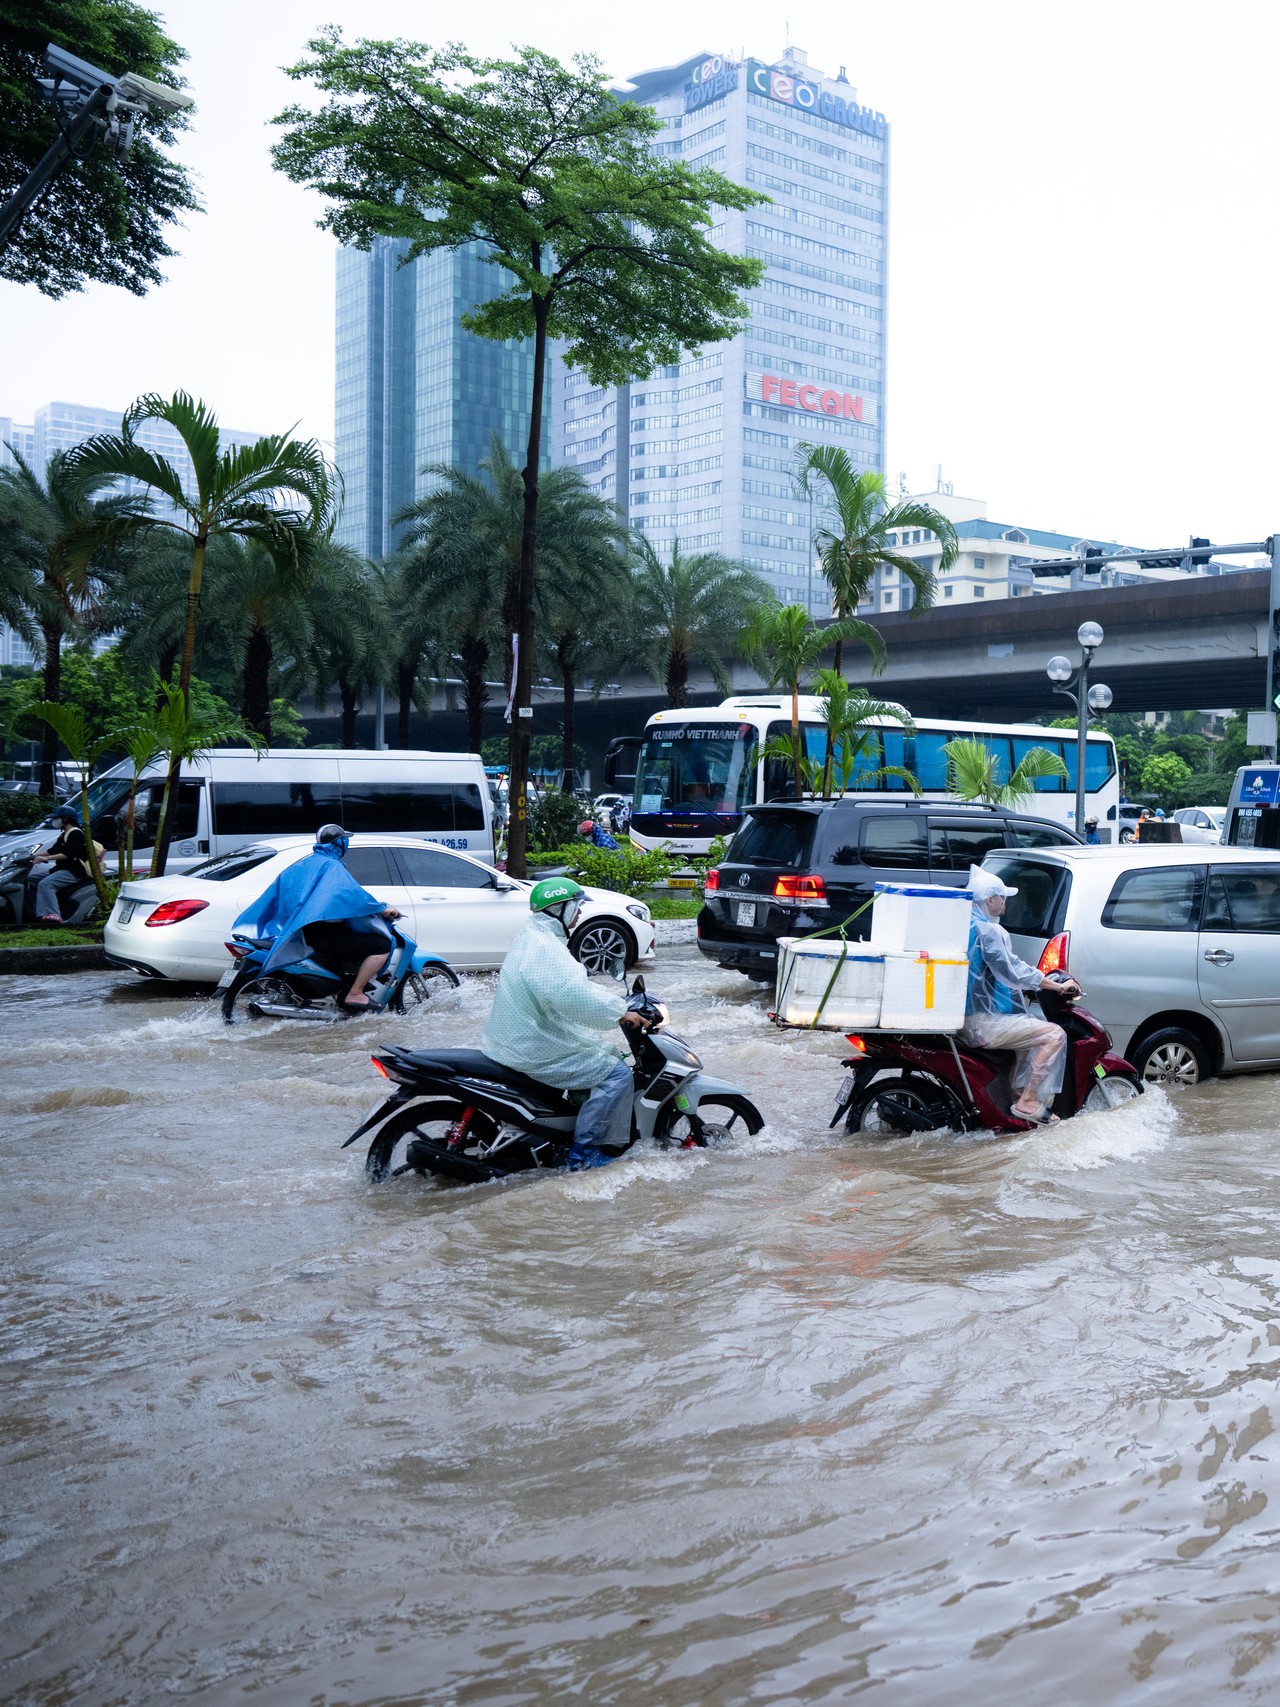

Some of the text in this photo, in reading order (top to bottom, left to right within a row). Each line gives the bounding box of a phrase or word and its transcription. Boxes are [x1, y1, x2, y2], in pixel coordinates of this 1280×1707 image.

[685, 74, 737, 107] TOWER
[753, 69, 887, 133] ceo GROUP
[762, 375, 863, 421] FECON
[652, 729, 685, 740] KUMHO
[544, 886, 568, 899] Grab
